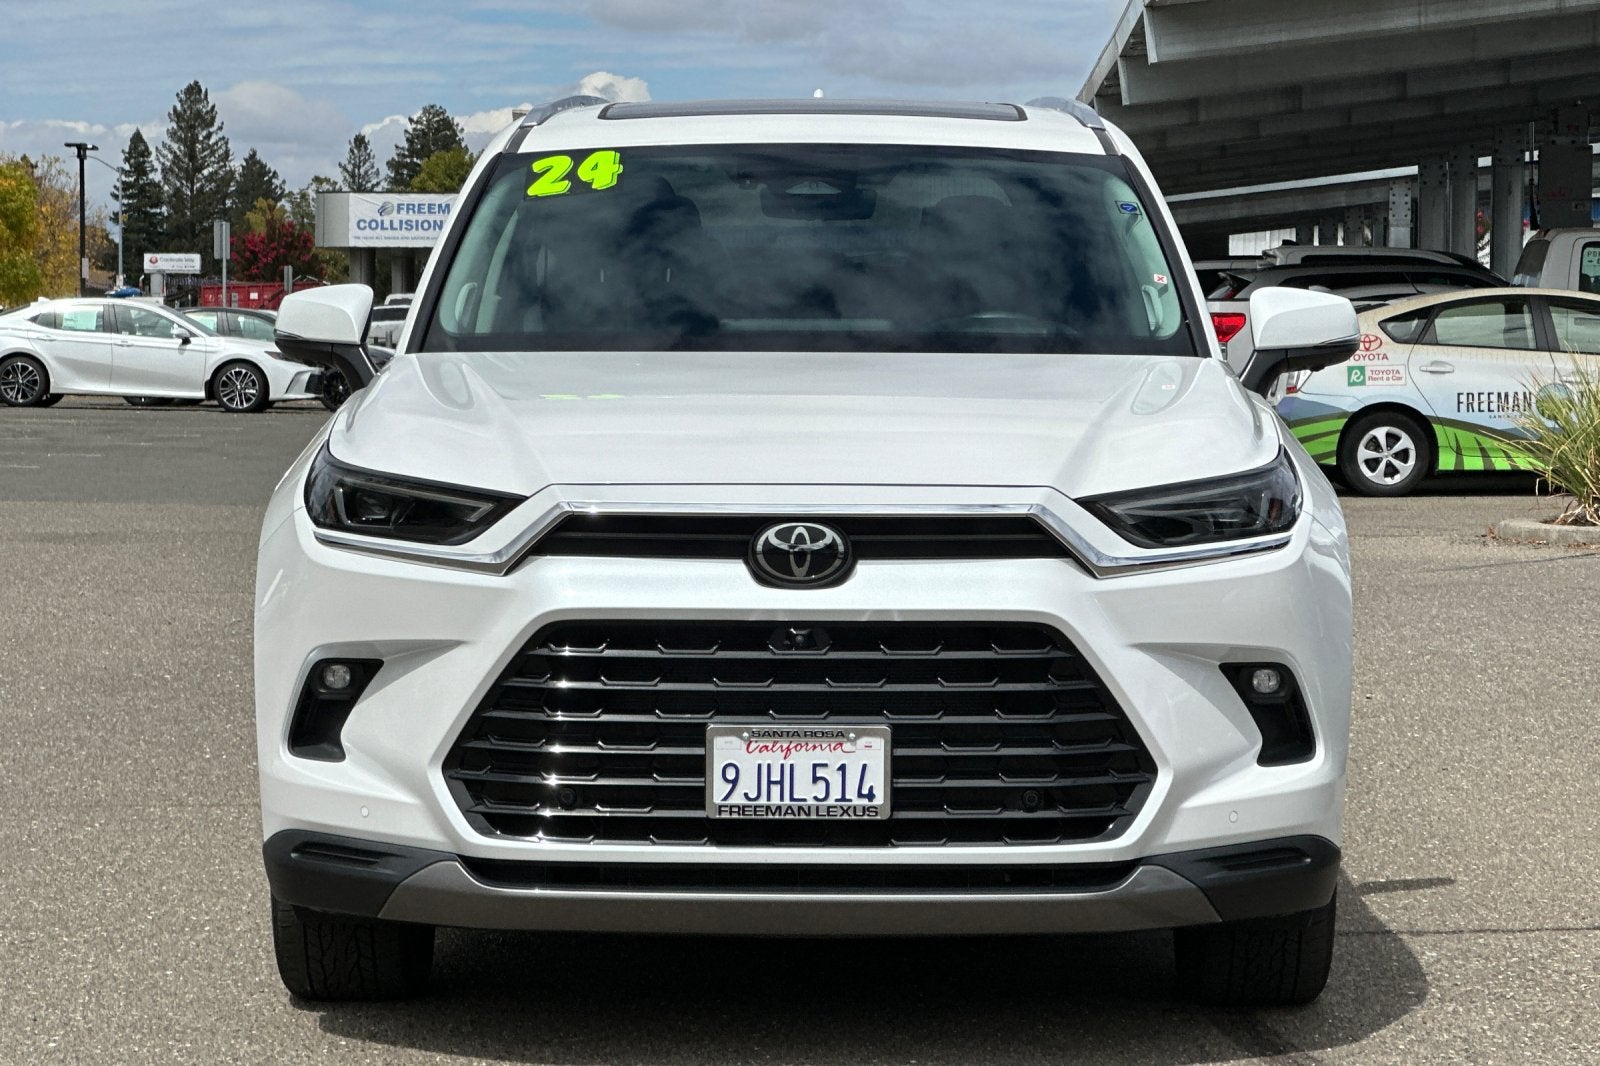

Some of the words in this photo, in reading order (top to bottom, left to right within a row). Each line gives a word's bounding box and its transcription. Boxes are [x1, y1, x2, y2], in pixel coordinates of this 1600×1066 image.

[527, 150, 623, 197] 24
[356, 218, 444, 231] COLLISION
[1349, 353, 1389, 361] OYOTA
[1457, 391, 1532, 413] FREEMAN
[751, 730, 800, 738] SANTA
[803, 730, 846, 738] ROSA
[745, 740, 856, 760] California
[720, 762, 877, 803] 9JHL514
[718, 805, 811, 817] FREEMAN
[815, 805, 879, 817] LEXUS
